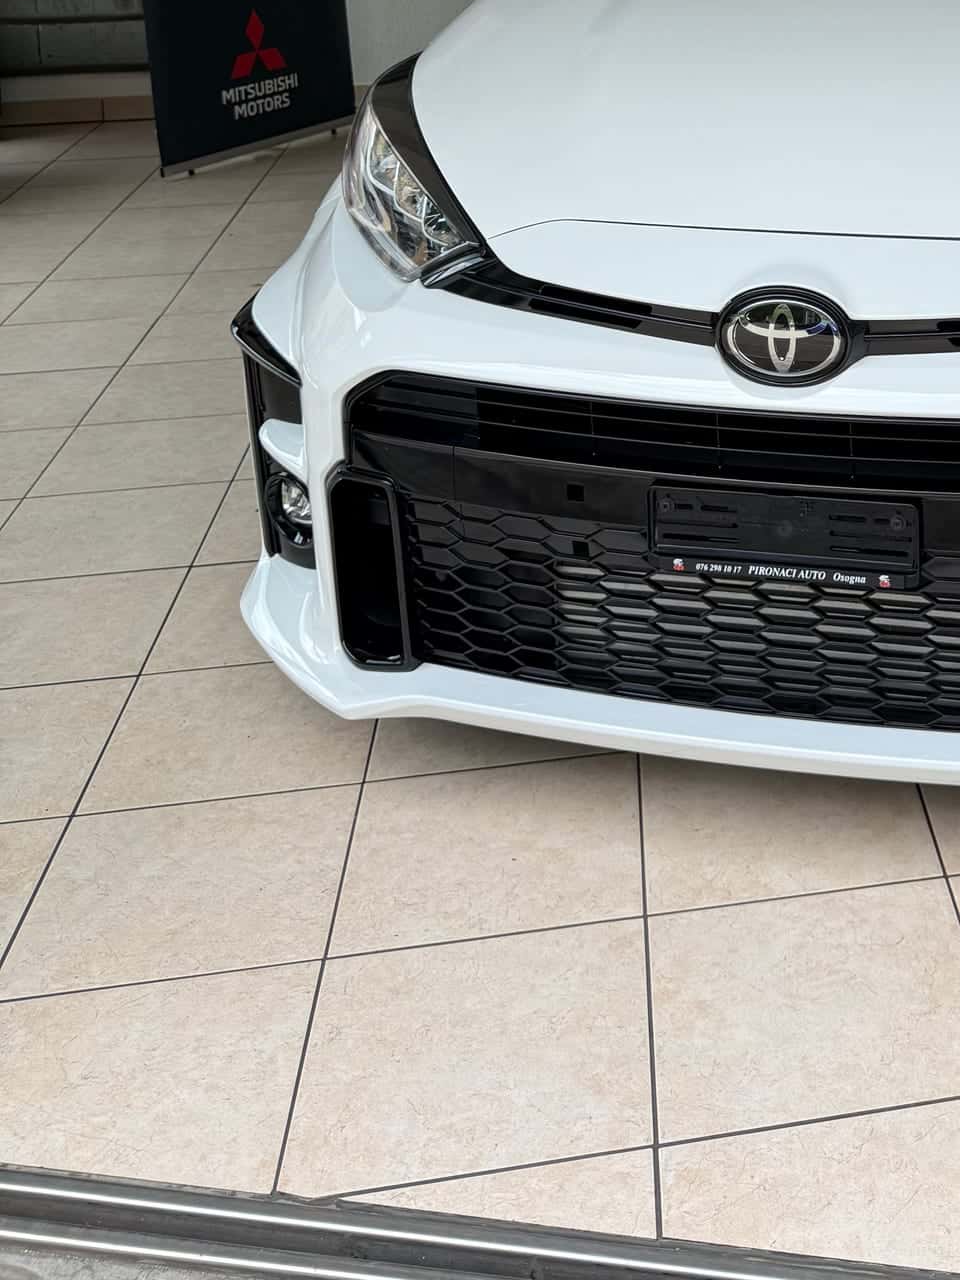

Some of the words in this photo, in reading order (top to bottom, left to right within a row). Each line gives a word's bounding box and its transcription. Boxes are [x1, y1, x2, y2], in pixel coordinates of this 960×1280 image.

[222, 72, 299, 105] MITSUBISHI
[234, 92, 291, 120] MOTORS
[695, 563, 709, 571] 076
[733, 565, 743, 574] 17
[748, 565, 797, 578] PIRONACI
[797, 568, 826, 580] AUTO
[833, 572, 866, 584] Osogna
